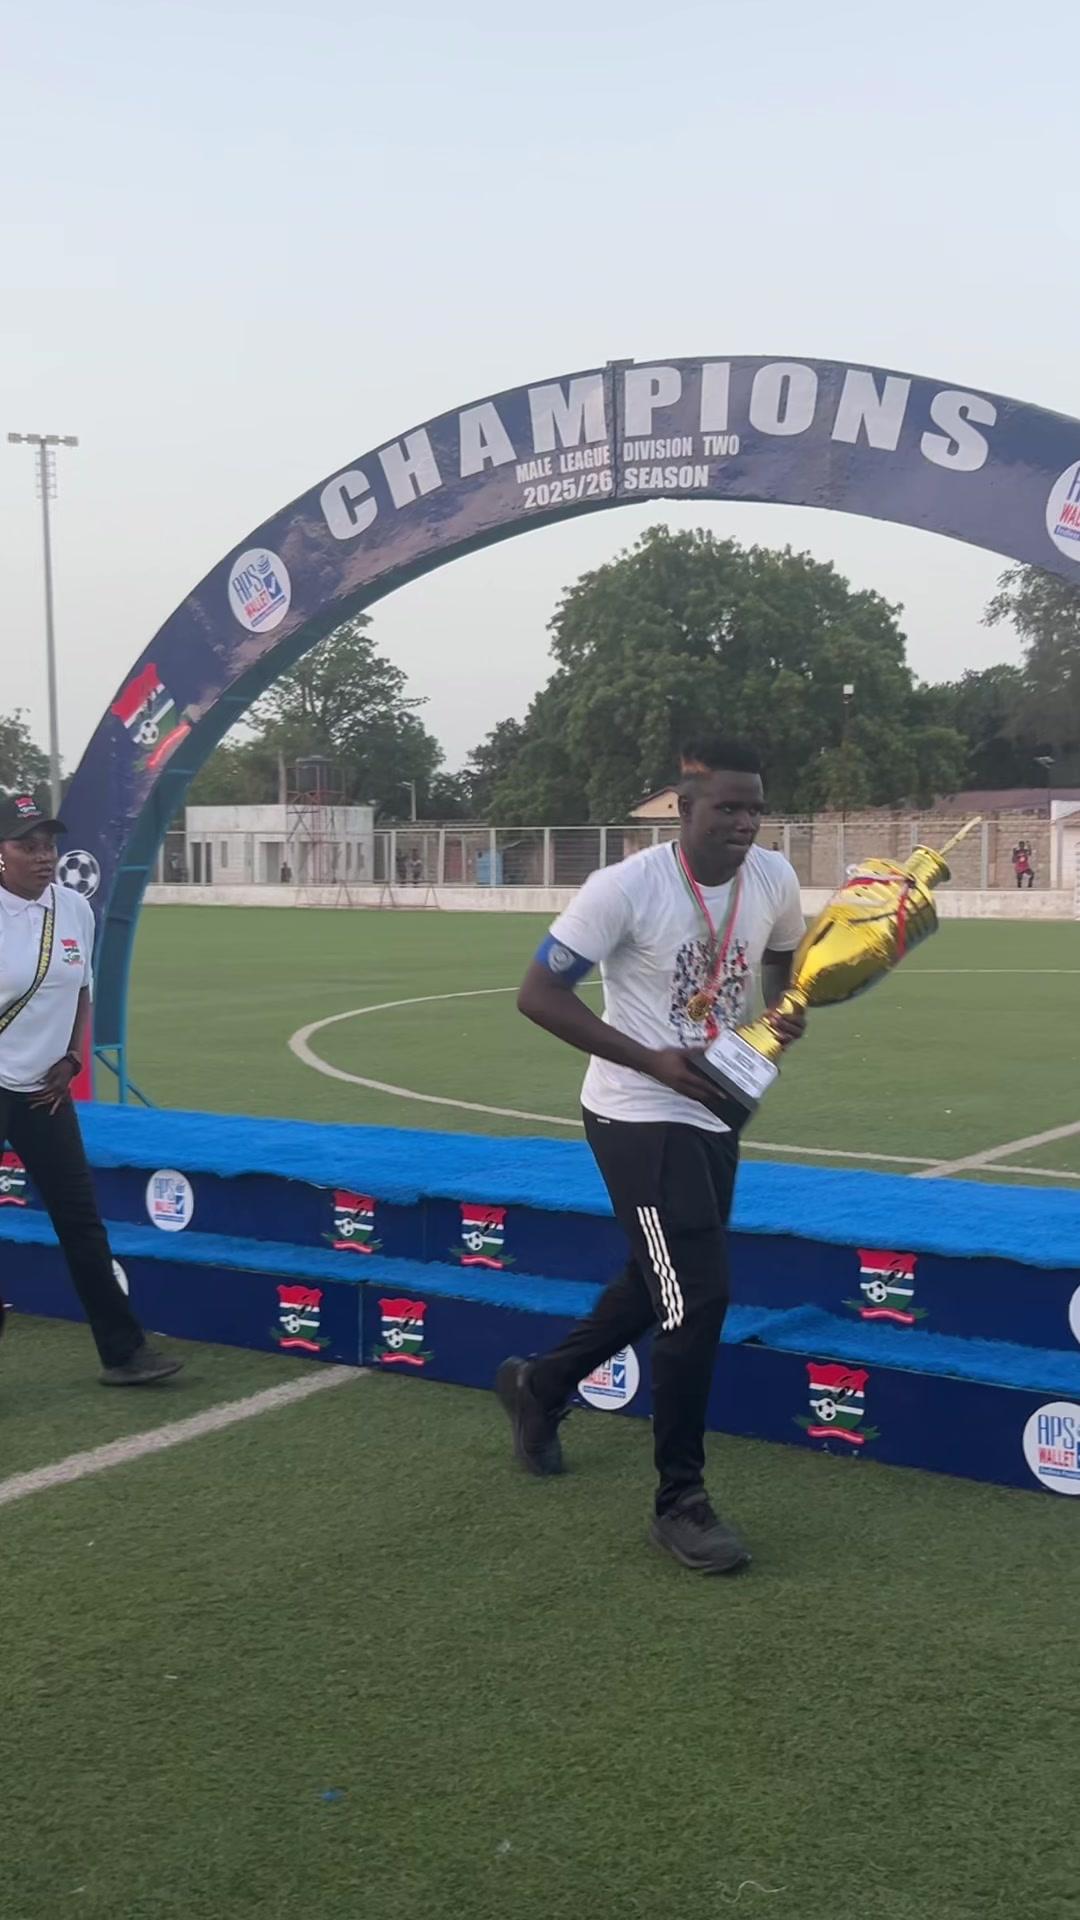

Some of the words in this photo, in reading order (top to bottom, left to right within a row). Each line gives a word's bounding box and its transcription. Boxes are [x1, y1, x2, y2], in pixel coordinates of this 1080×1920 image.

[320, 362, 998, 541] CHAMPIONS
[516, 457, 552, 483] MALE
[559, 445, 611, 473] LEAGUE
[623, 437, 693, 462] DIVISION
[703, 435, 740, 457] TWO
[523, 470, 612, 508] 2025/26
[624, 465, 710, 490] SEASON
[232, 564, 263, 604] APS
[1038, 1414, 1074, 1449] APS
[1039, 1448, 1074, 1467] WALLET
